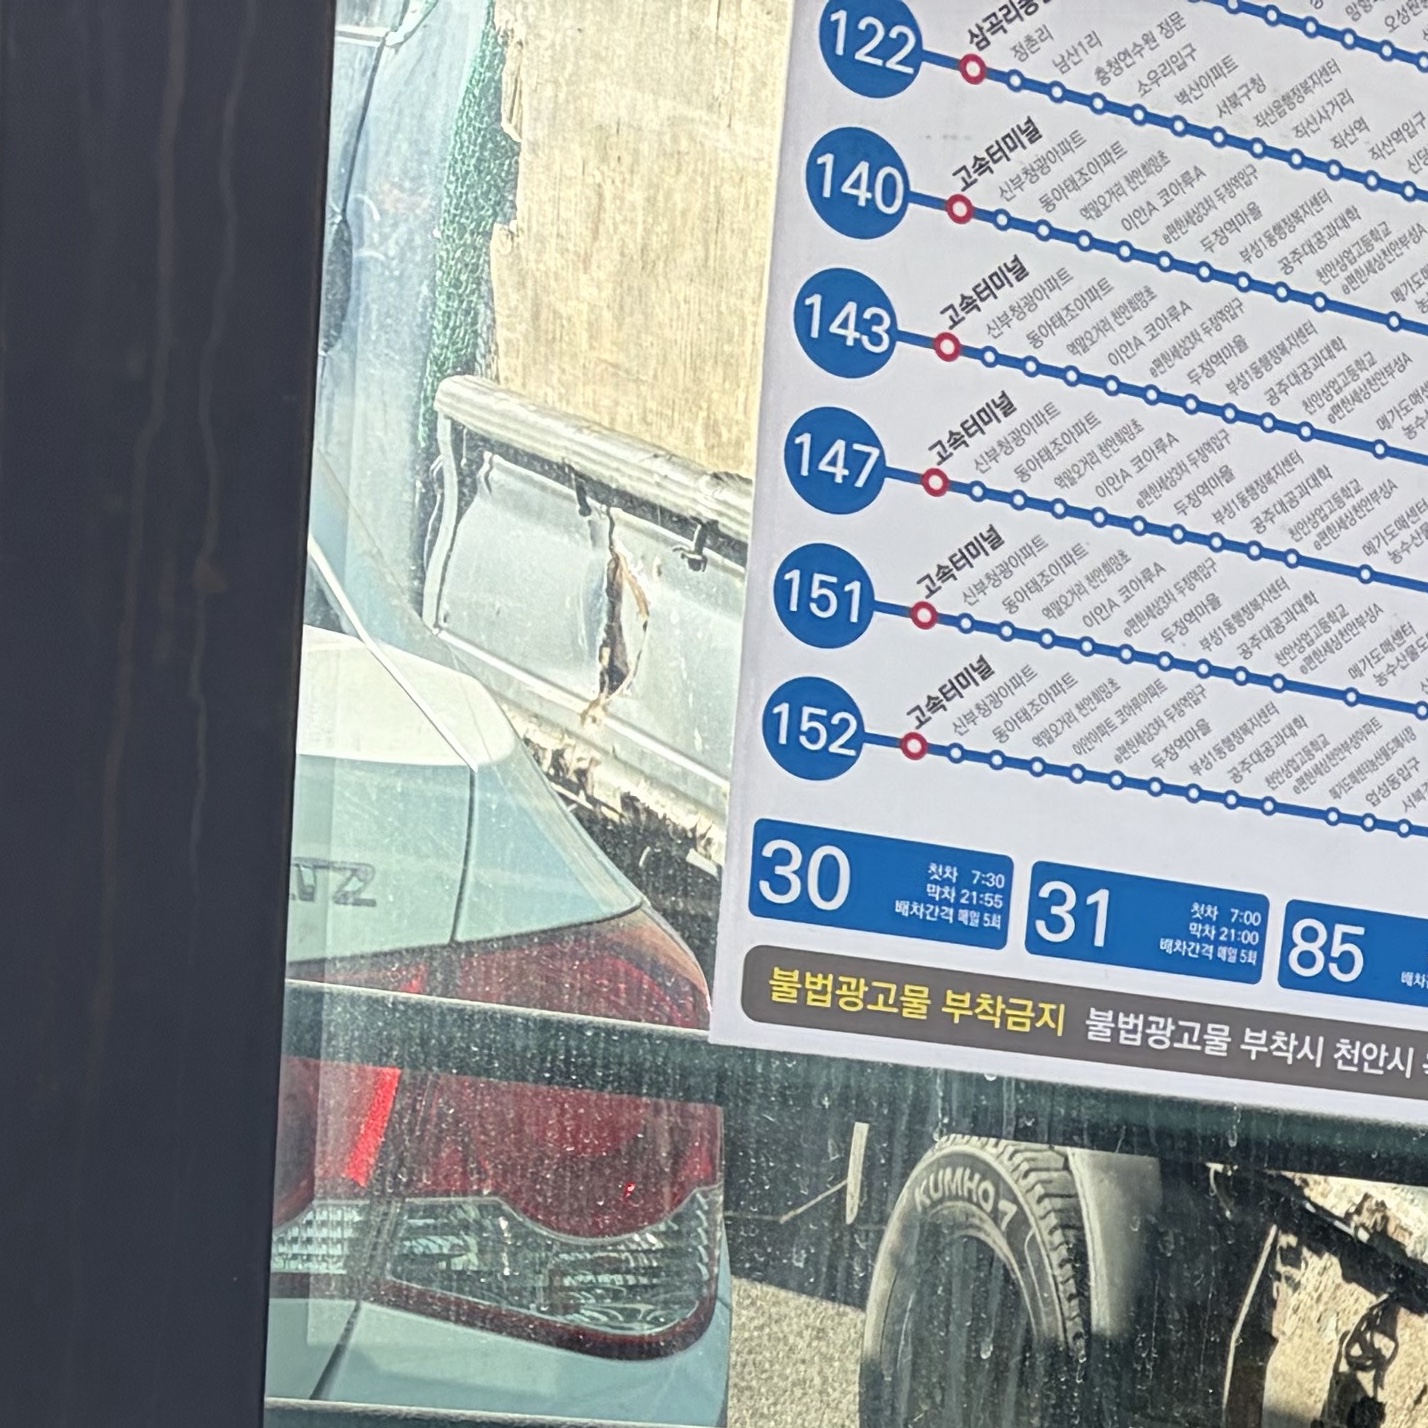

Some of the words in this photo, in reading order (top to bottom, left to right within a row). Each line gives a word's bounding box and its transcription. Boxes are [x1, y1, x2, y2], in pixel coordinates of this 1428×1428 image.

[824, 15, 915, 81] 122
[817, 147, 909, 214] 140
[952, 116, 1043, 192] 고속터미널
[805, 288, 895, 353] 143
[940, 254, 1030, 330] 고속터미널
[795, 428, 883, 487] 147
[928, 390, 1018, 466] 고속터미널
[916, 524, 1005, 600] 고속터미널
[784, 570, 860, 622] 151
[906, 654, 995, 730] 고속터미널
[773, 703, 857, 756] 152
[759, 840, 850, 910] 30
[926, 884, 956, 903] 막차
[960, 890, 1003, 908] 21:55
[928, 862, 958, 882] 첫차
[972, 870, 1005, 888] 7:30
[894, 900, 954, 923] 배차간격
[1036, 881, 1109, 946] 31
[1289, 919, 1364, 982] 85
[768, 966, 930, 1019] 불법광고물
[941, 989, 1065, 1036] 부착금지
[1085, 1007, 1231, 1056] 불법광고물
[1240, 1027, 1323, 1067] 부착시
[1333, 1038, 1414, 1078] 천안시
